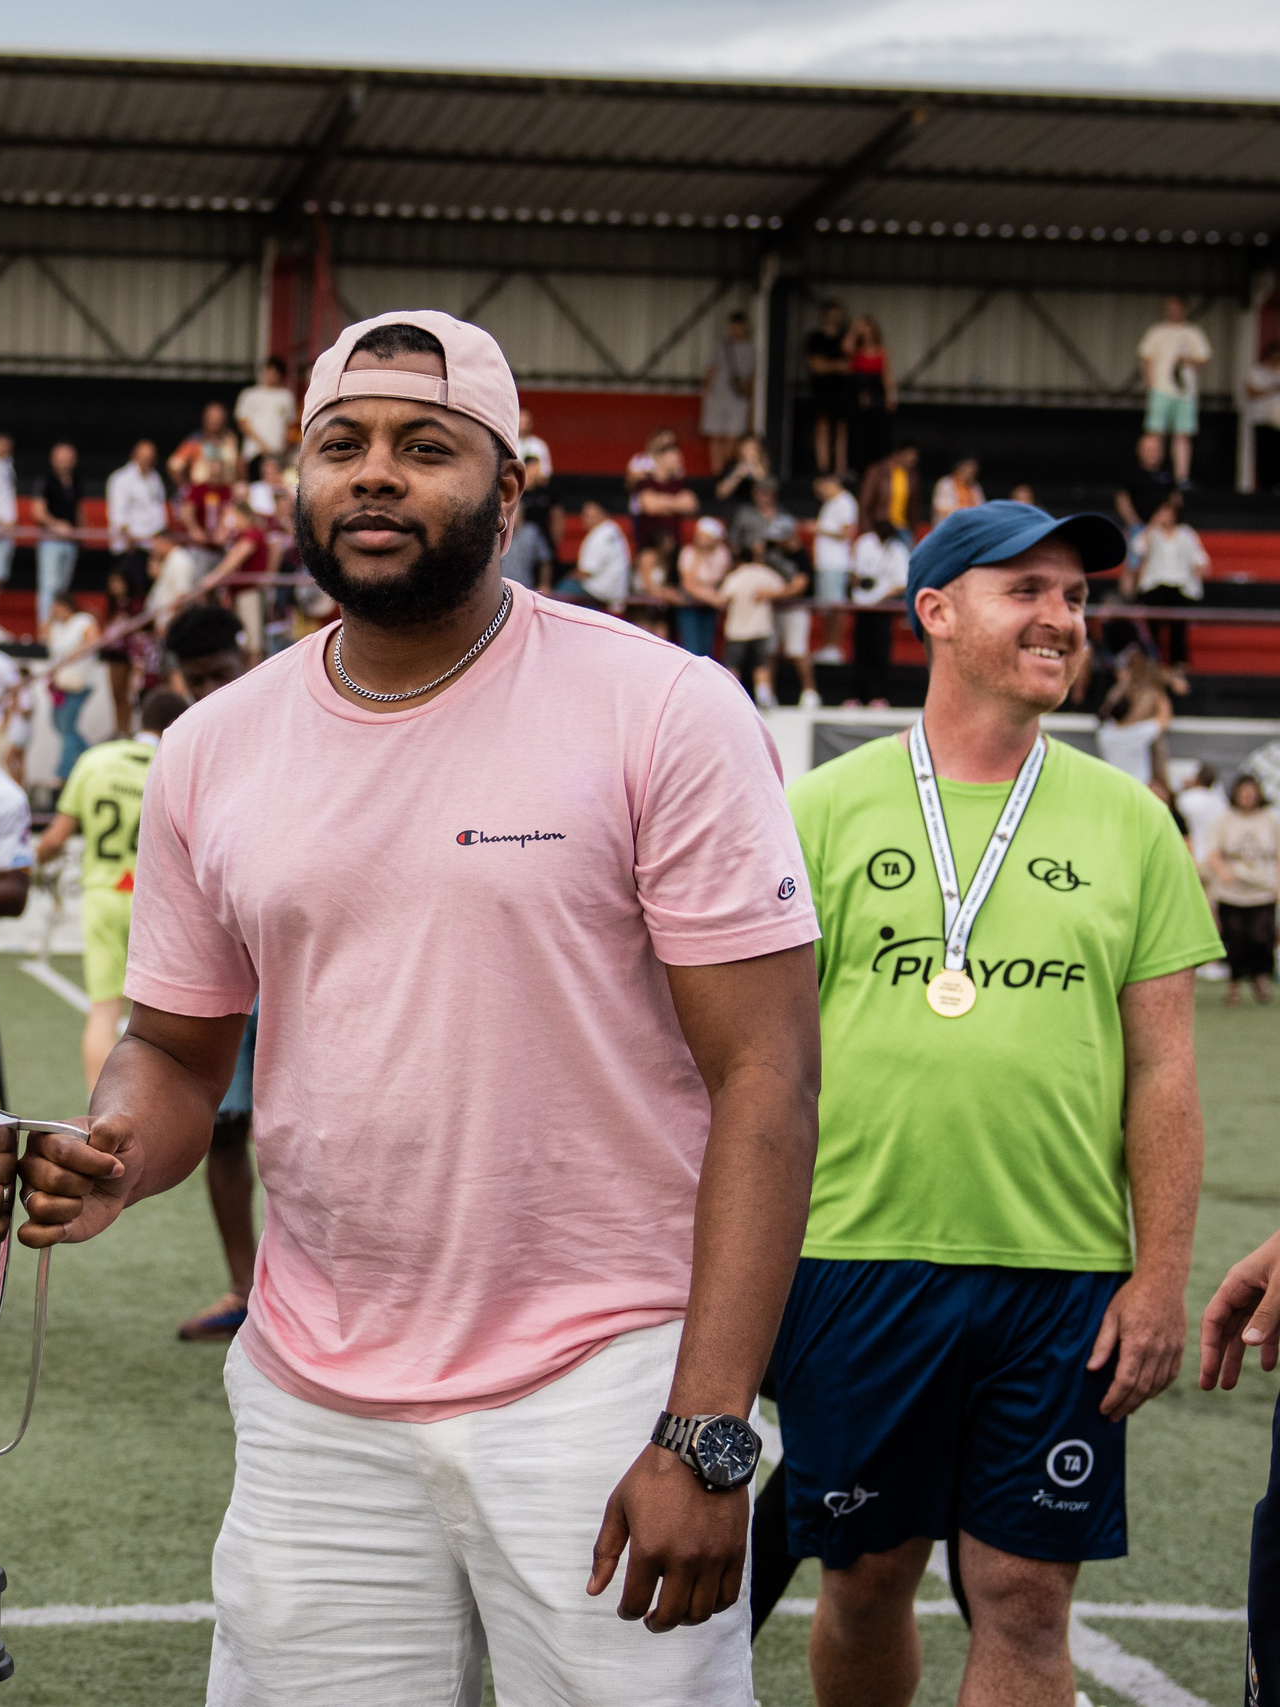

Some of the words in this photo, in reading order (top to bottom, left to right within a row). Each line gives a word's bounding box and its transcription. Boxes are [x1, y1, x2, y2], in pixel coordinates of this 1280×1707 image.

[456, 829, 567, 849] Champion
[881, 862, 901, 877] TA
[1063, 1454, 1082, 1473] TA
[1040, 1498, 1091, 1512] PLAYOFF
